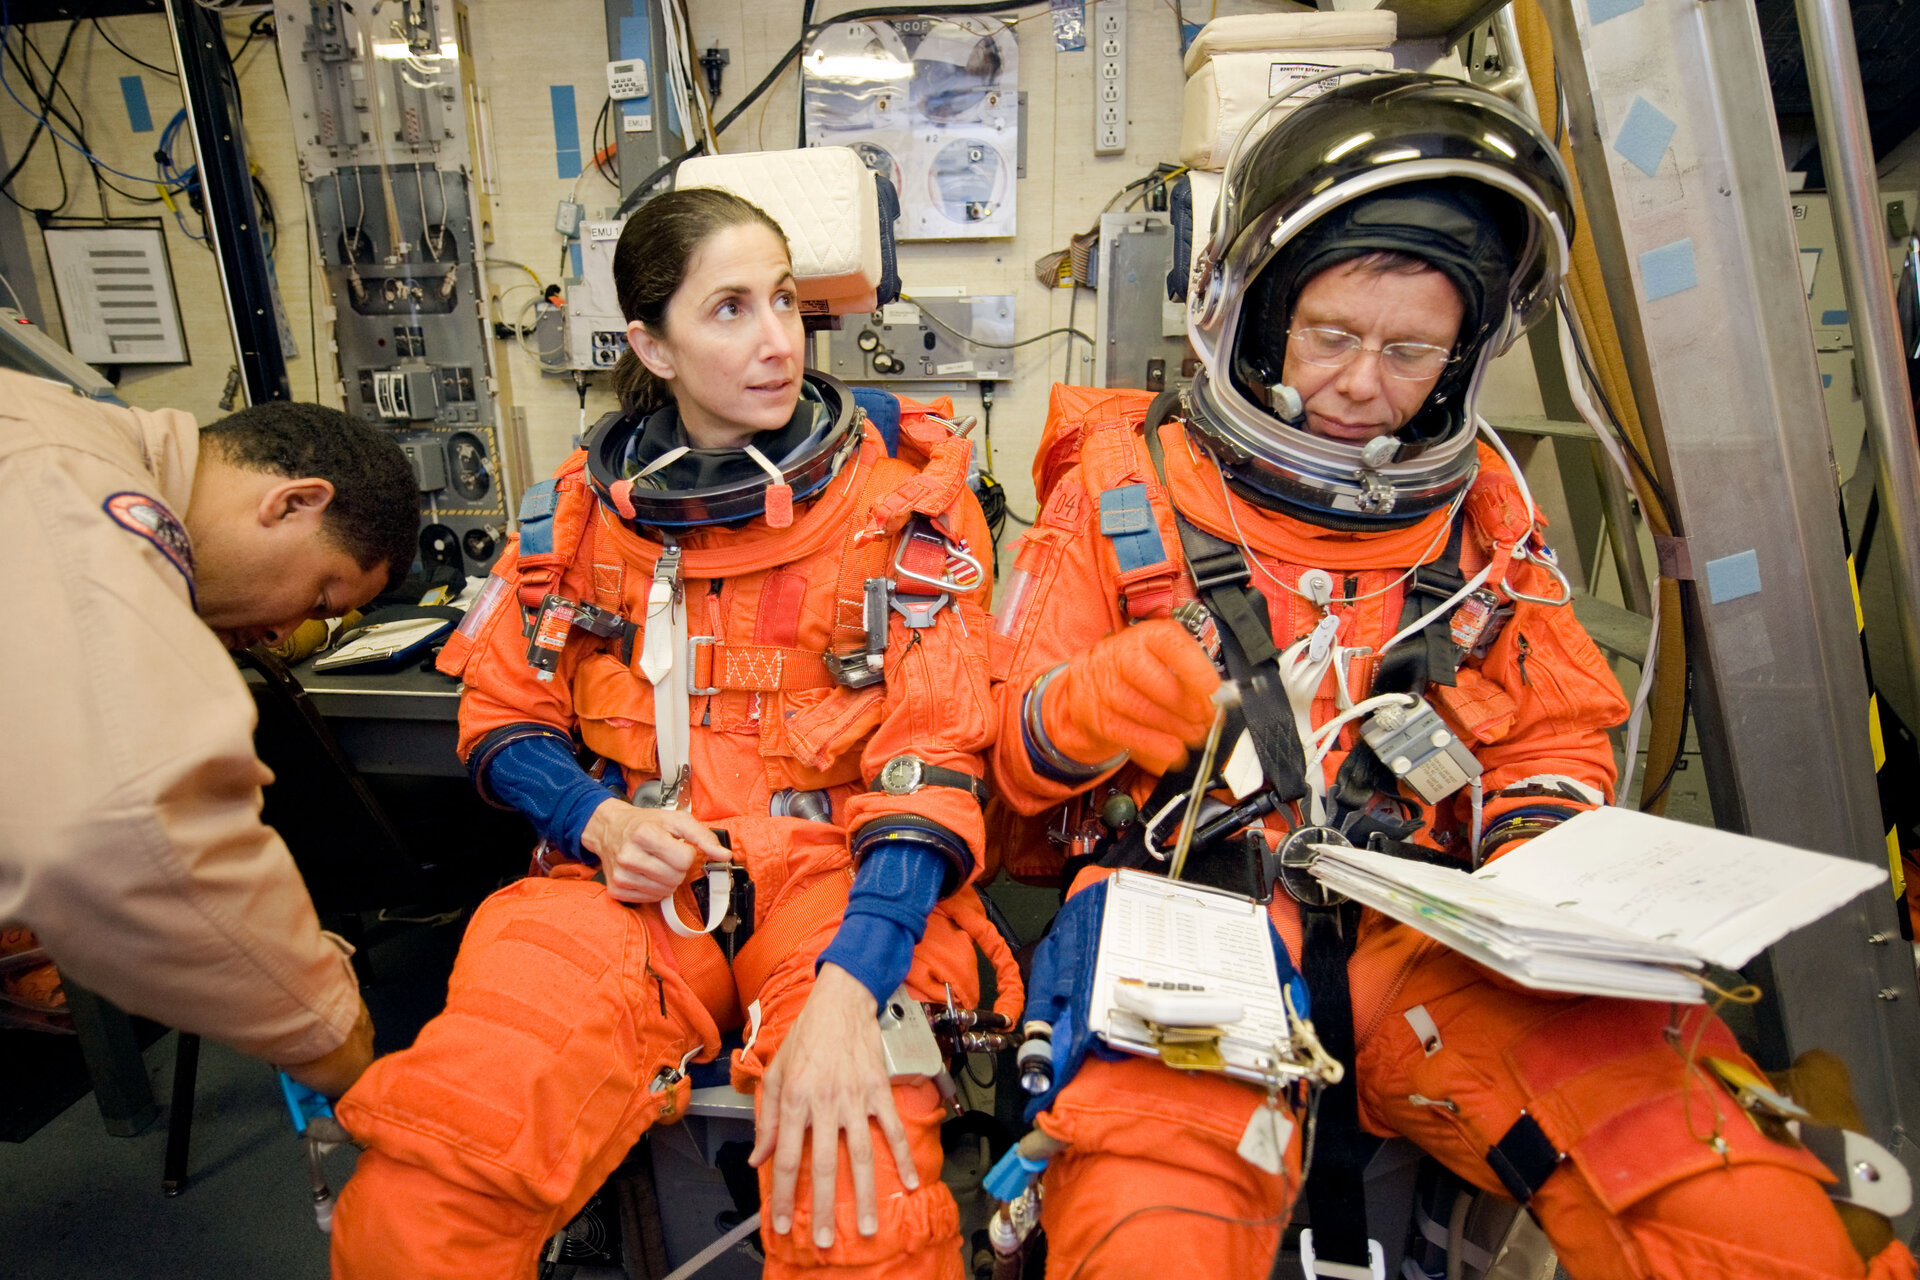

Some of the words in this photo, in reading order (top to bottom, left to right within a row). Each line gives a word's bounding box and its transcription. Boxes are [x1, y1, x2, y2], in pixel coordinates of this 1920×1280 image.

[894, 21, 929, 32] SCOF
[627, 119, 643, 127] EMU
[591, 228, 613, 237] EMU
